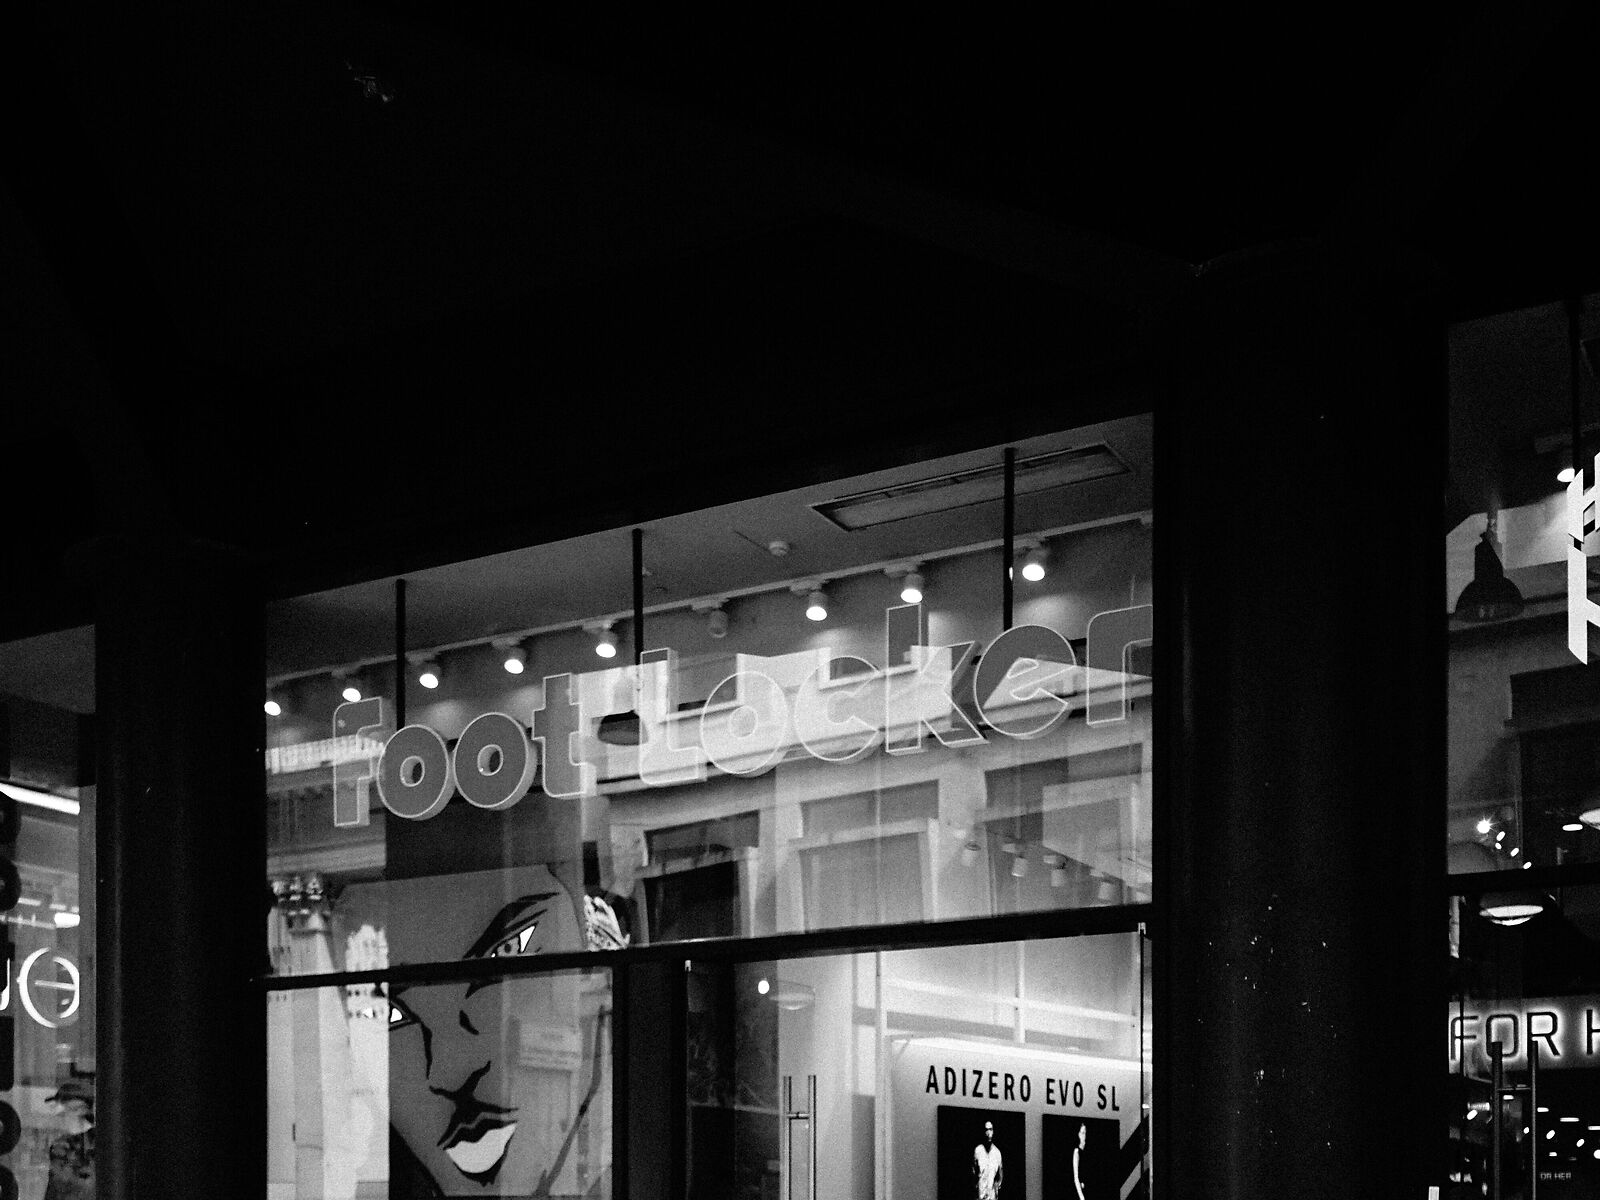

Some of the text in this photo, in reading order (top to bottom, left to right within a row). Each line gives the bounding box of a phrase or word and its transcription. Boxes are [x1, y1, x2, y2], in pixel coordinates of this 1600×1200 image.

[639, 602, 1152, 786] Locker
[1450, 1010, 1561, 1060] FOR
[925, 1065, 1120, 1112] ADIZERO EVO SL
